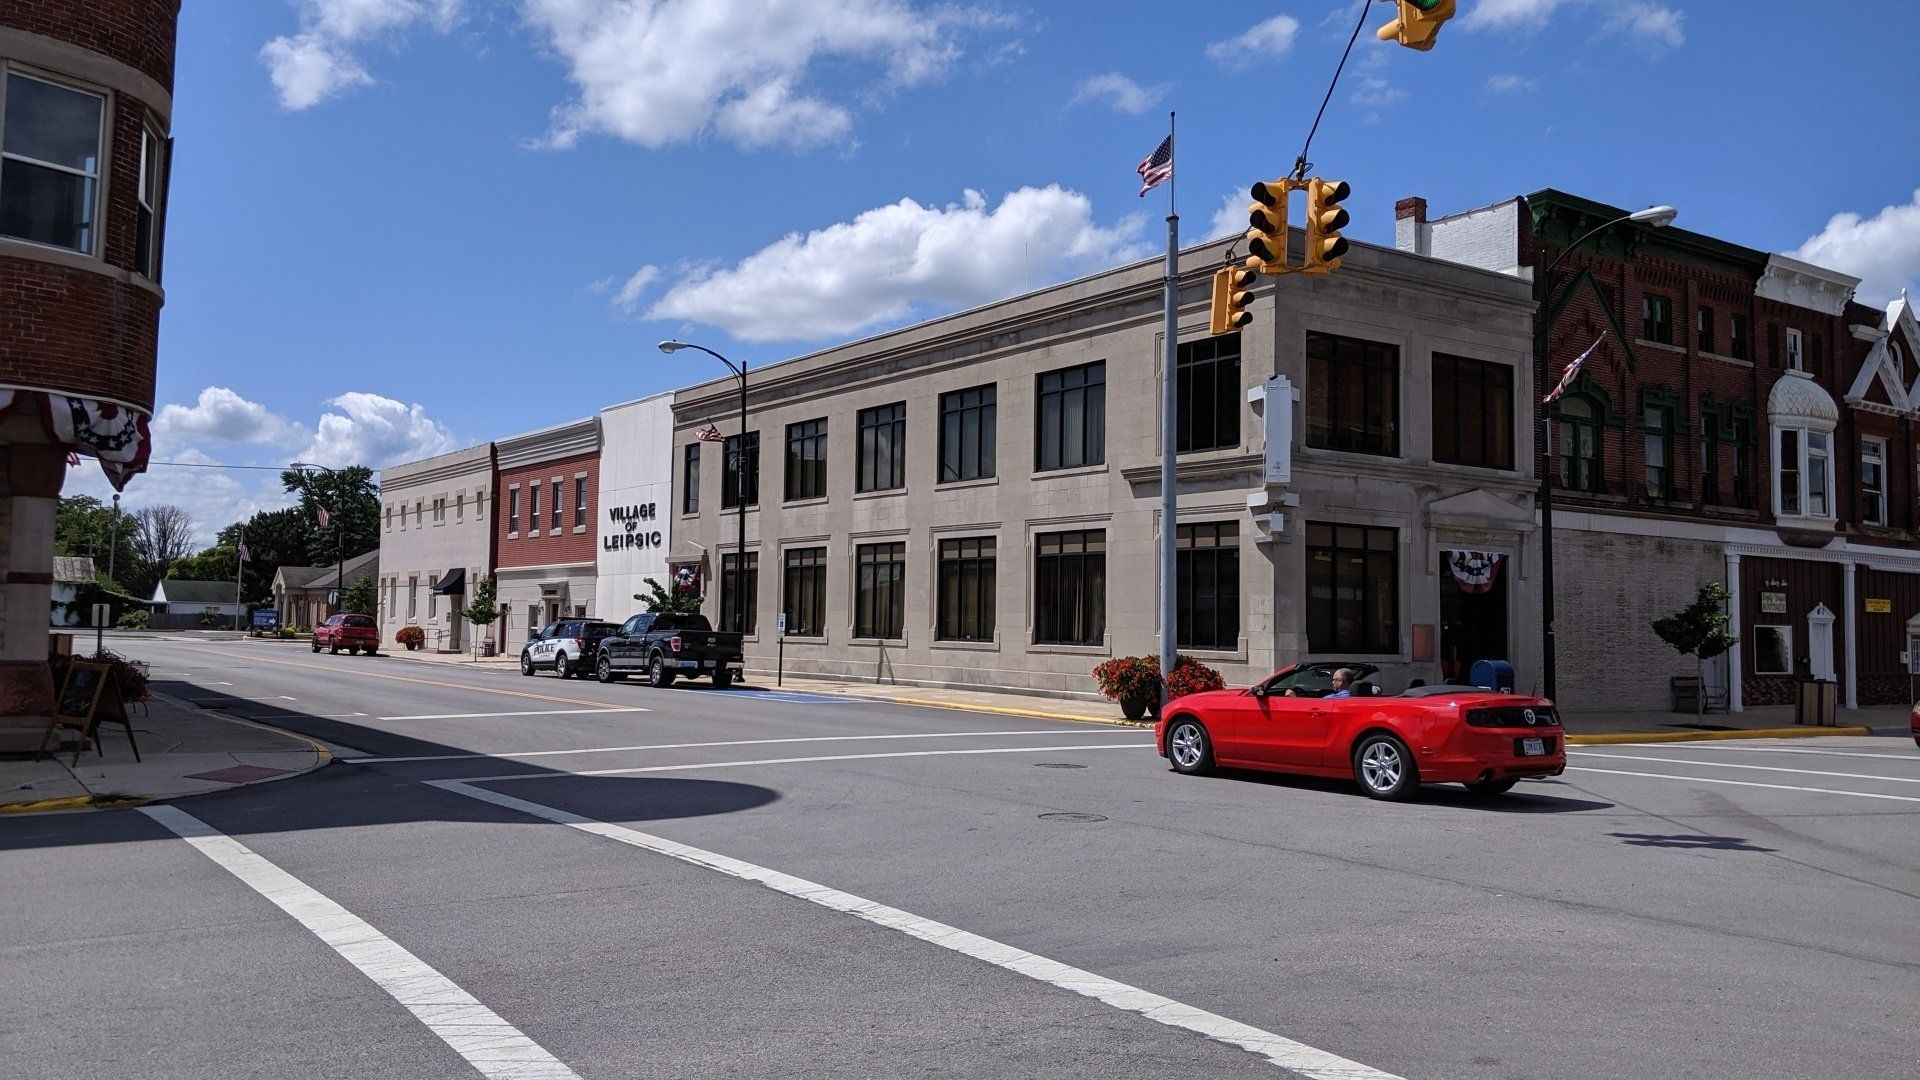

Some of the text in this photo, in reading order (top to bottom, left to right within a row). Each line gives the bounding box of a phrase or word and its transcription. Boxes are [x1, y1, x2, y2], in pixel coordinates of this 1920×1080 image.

[609, 503, 656, 521] VILLAGE
[625, 522, 637, 532] OF
[604, 531, 661, 550] LEIPSIC
[534, 644, 555, 655] POLICE
